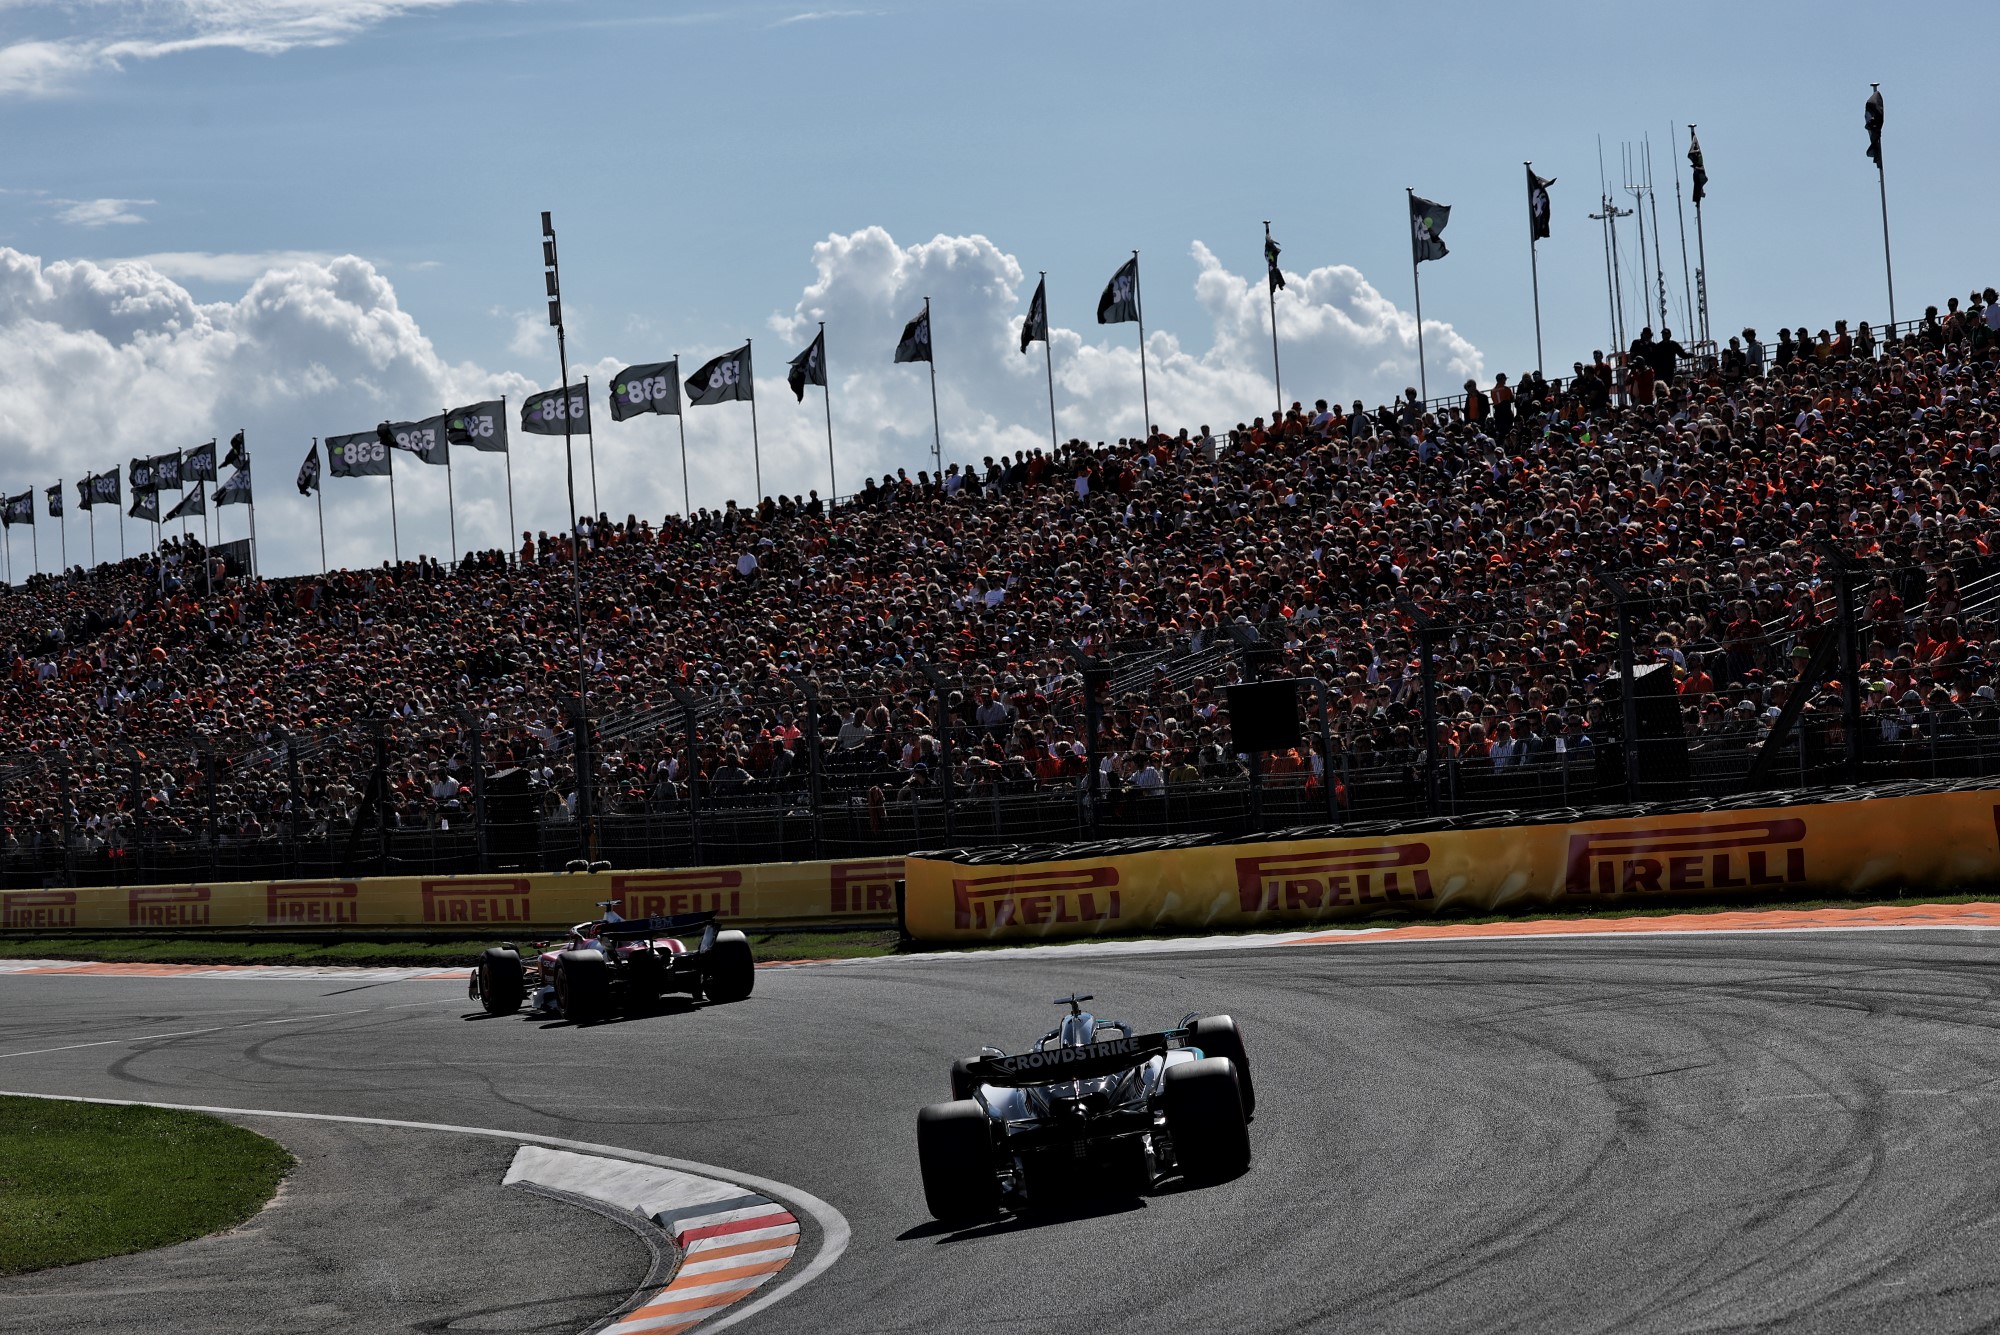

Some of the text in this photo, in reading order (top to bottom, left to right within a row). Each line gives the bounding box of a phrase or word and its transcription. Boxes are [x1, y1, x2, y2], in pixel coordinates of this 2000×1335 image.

[1235, 842, 1434, 913] PIRELLI
[1565, 817, 1807, 895] PIRELLI
[2, 892, 77, 928] PIRELLI
[129, 887, 211, 926] PIRELLI
[267, 883, 358, 923] PIRELLI
[421, 878, 531, 922] PIRELLI
[611, 870, 743, 919] PIRELLI
[953, 867, 1120, 930] PIRELLI
[1003, 1037, 1140, 1072] CROWDSTRIKE
